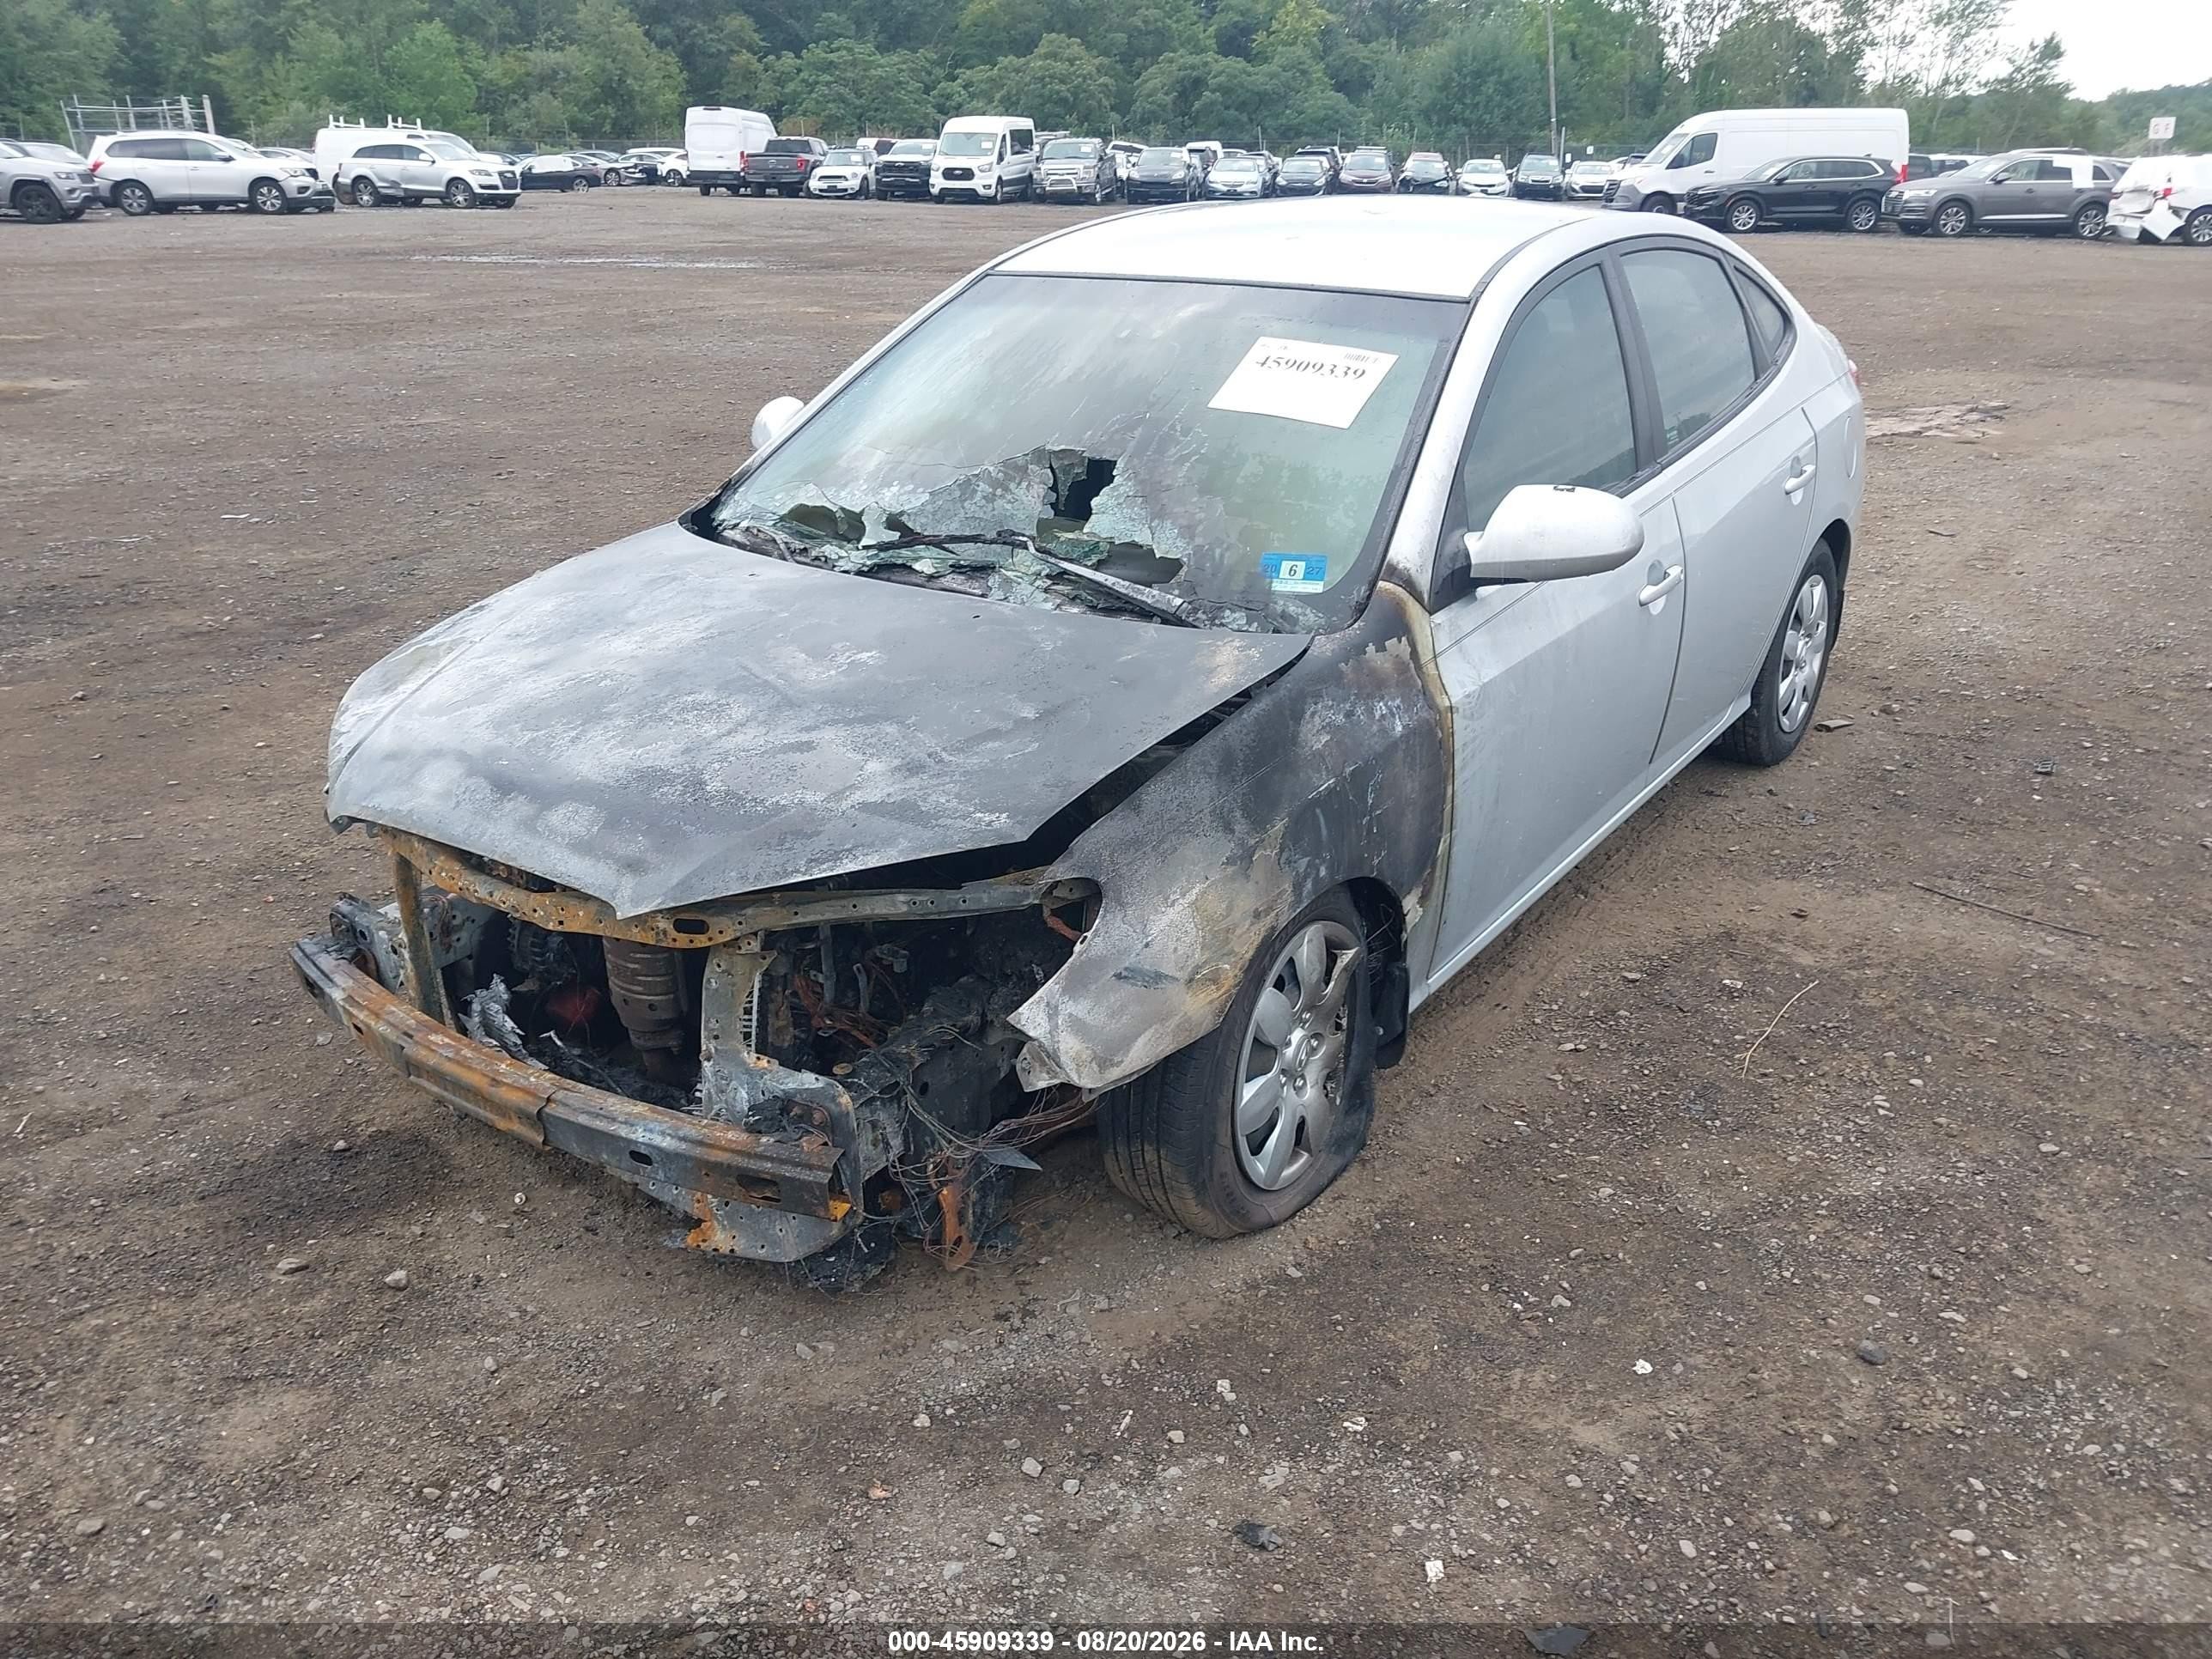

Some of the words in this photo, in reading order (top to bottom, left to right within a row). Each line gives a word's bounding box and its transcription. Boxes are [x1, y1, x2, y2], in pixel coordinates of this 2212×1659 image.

[1255, 355, 1366, 380] 45909339
[1263, 563, 1278, 574] 20
[1288, 563, 1298, 577] 6
[1306, 567, 1323, 575] 27
